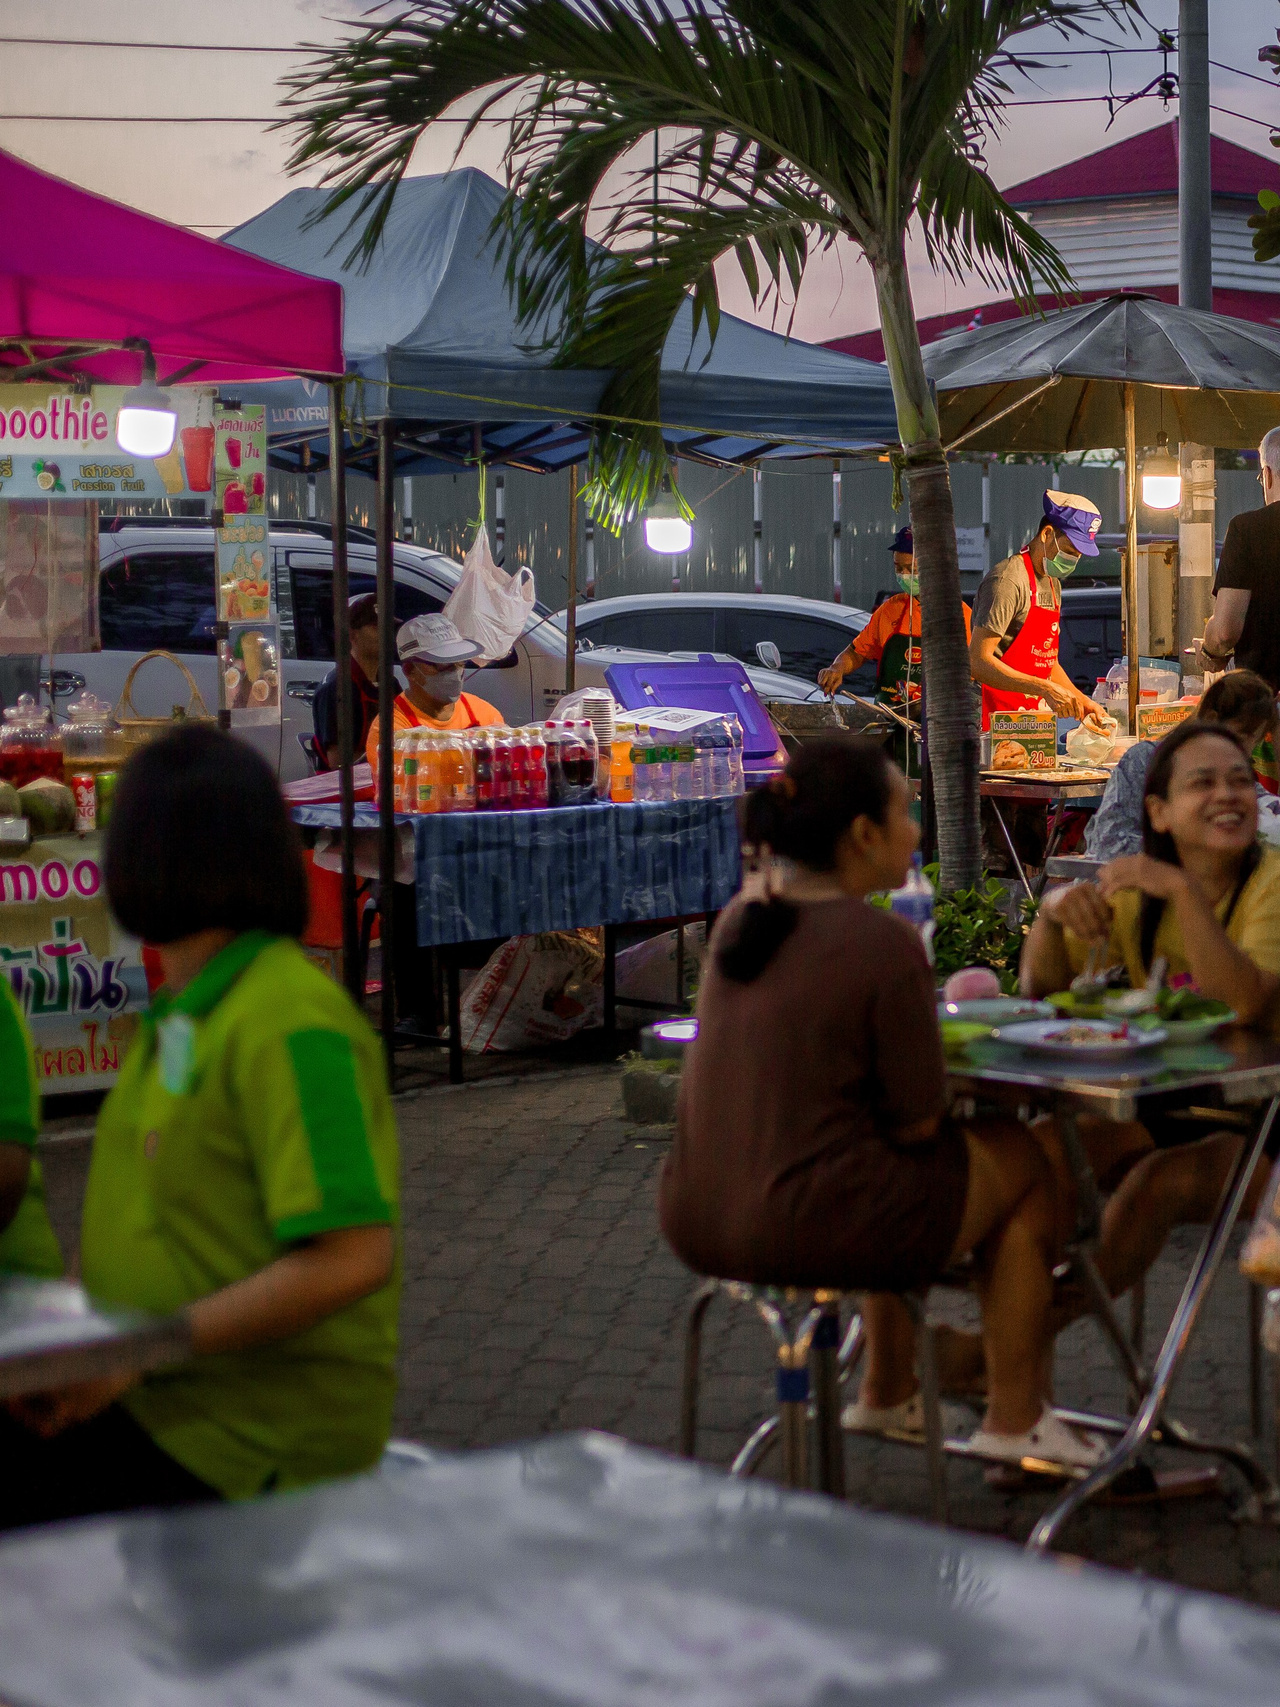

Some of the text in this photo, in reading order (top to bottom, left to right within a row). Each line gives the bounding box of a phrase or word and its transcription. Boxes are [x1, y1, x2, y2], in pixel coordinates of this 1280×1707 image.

[0, 398, 109, 441] oothie
[271, 406, 329, 423] LUCKYFRI
[79, 464, 135, 479] เสาวรส
[72, 479, 145, 492] Passion Fruit
[1031, 751, 1044, 764] 20
[36, 1023, 119, 1077] ผลไม้
